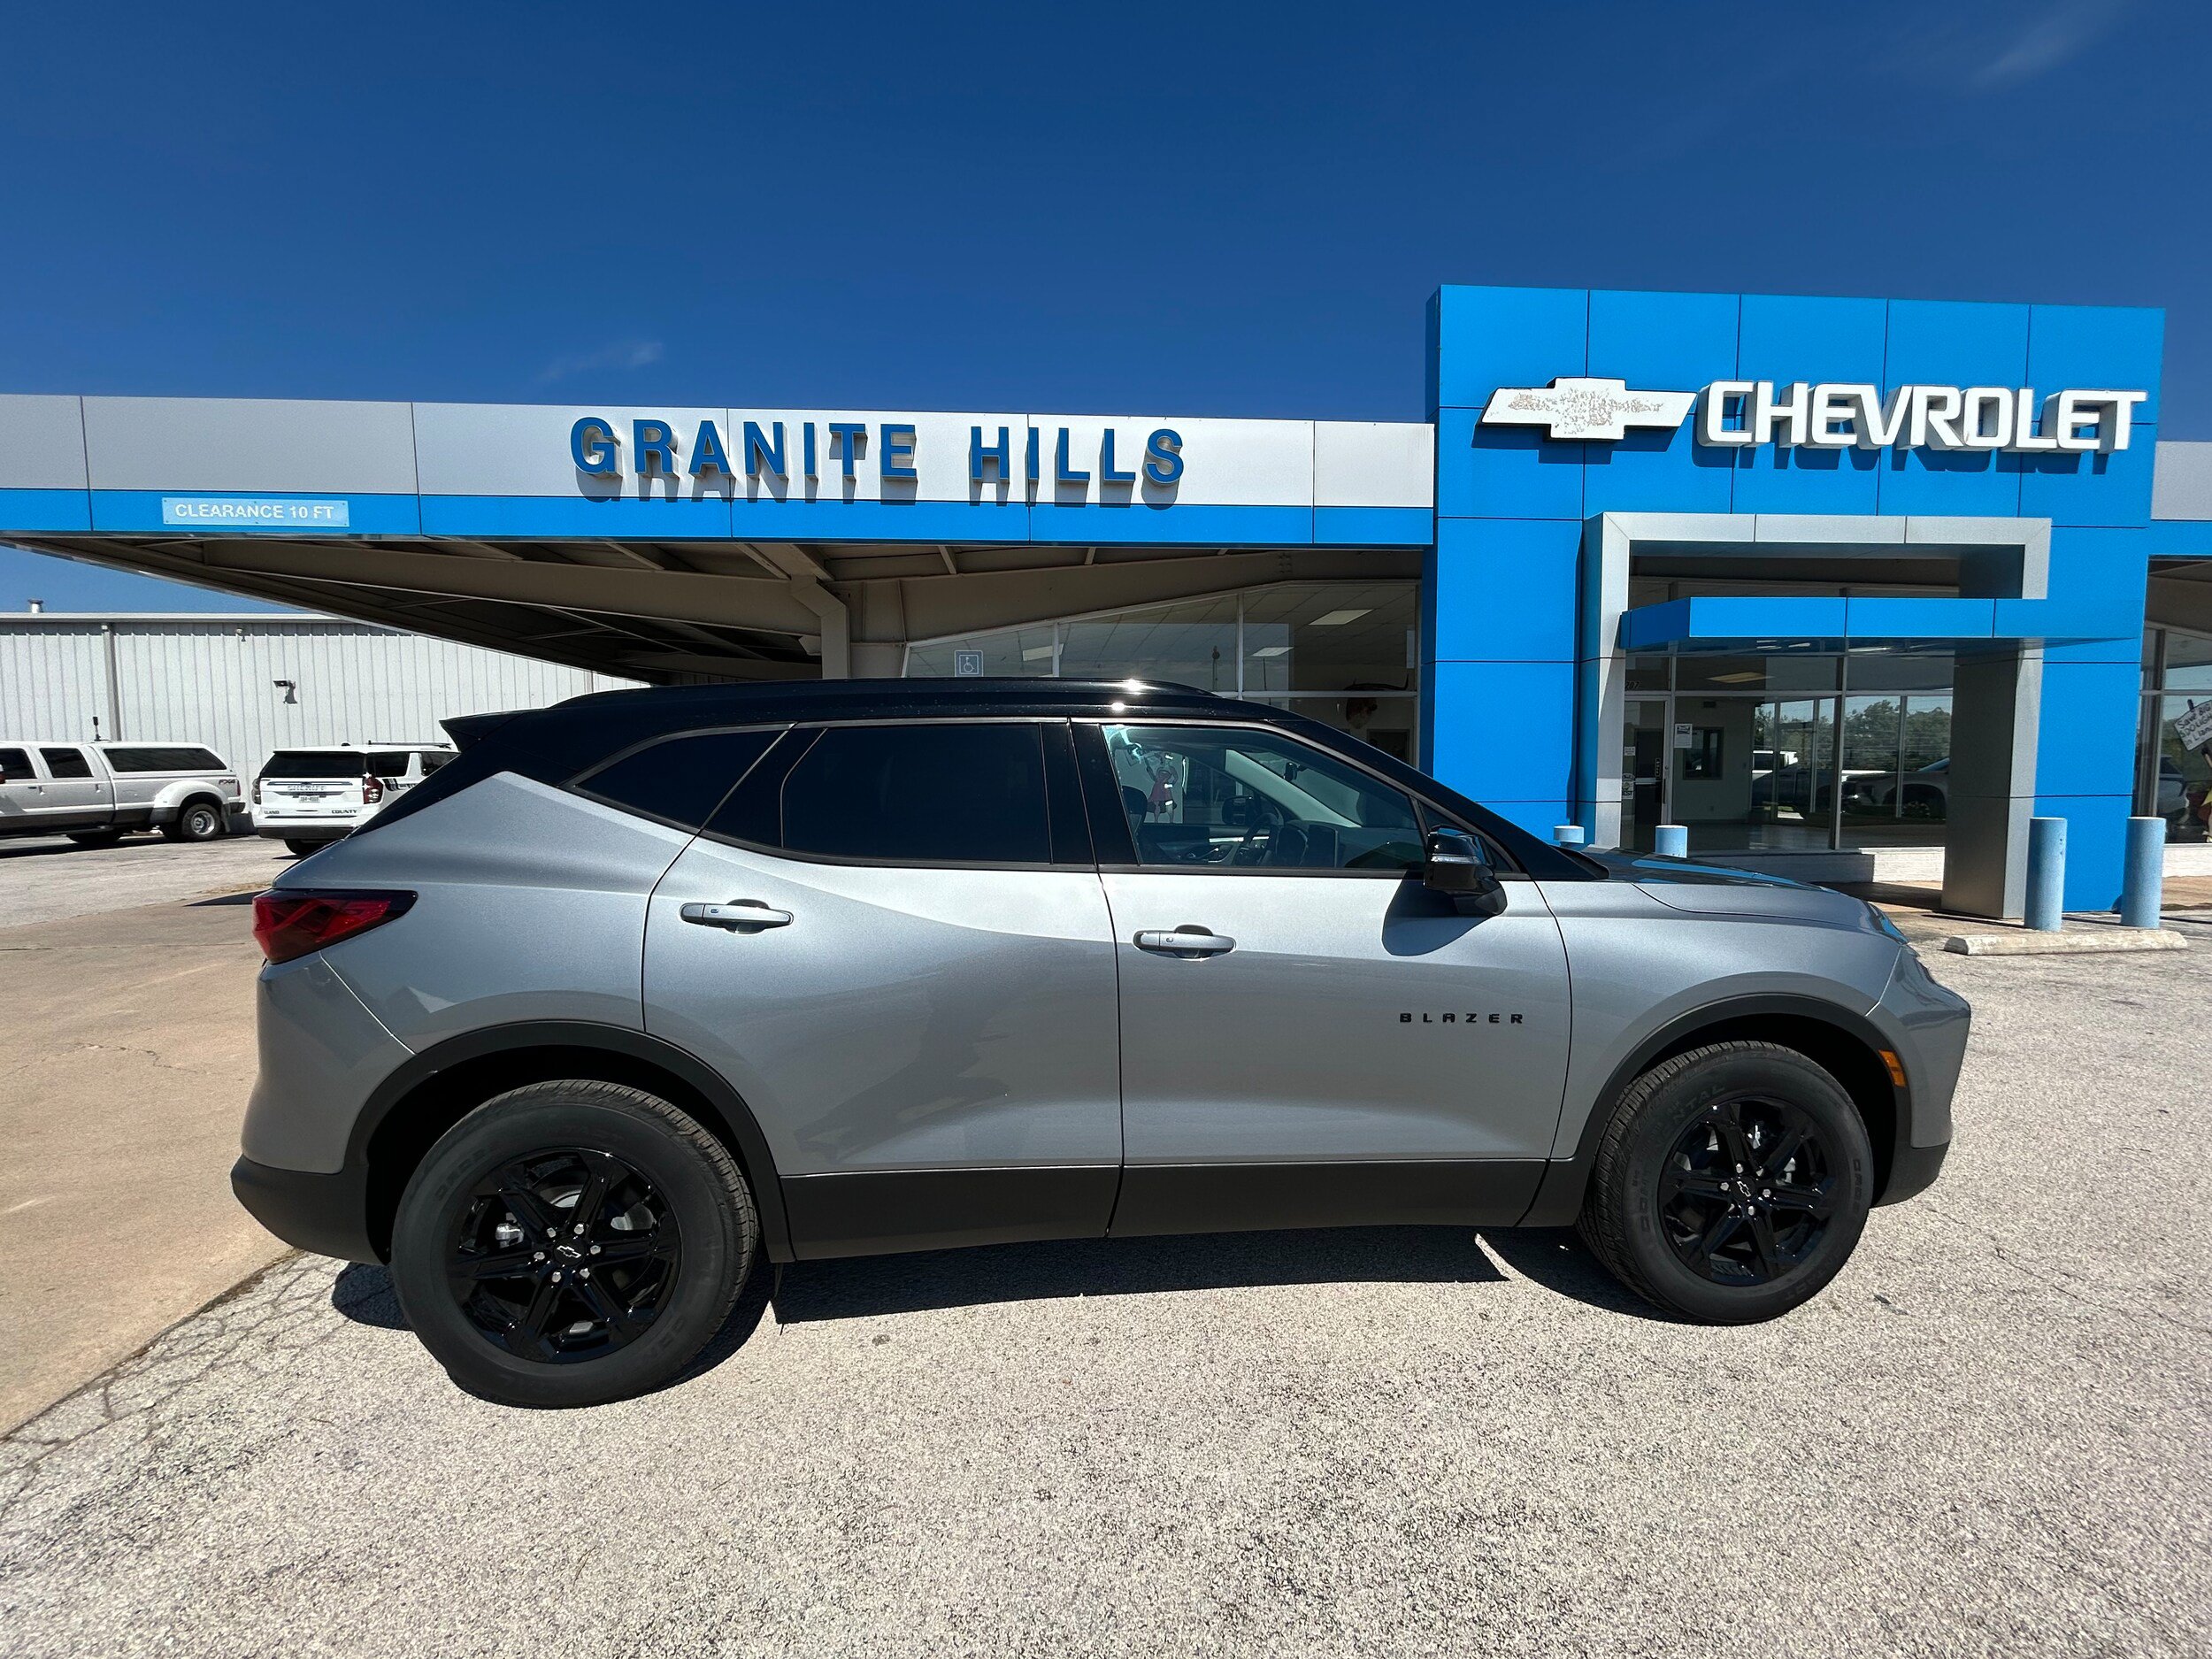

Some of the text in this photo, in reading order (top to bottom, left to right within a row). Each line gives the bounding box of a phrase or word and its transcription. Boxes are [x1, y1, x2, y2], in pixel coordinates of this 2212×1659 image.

[1705, 380, 2147, 450] CHEVROLET
[569, 417, 1186, 488] GRANITE HILLS
[175, 503, 335, 519] CLEARANCE 10 FT
[1399, 1012, 1524, 1024] BLAZER
